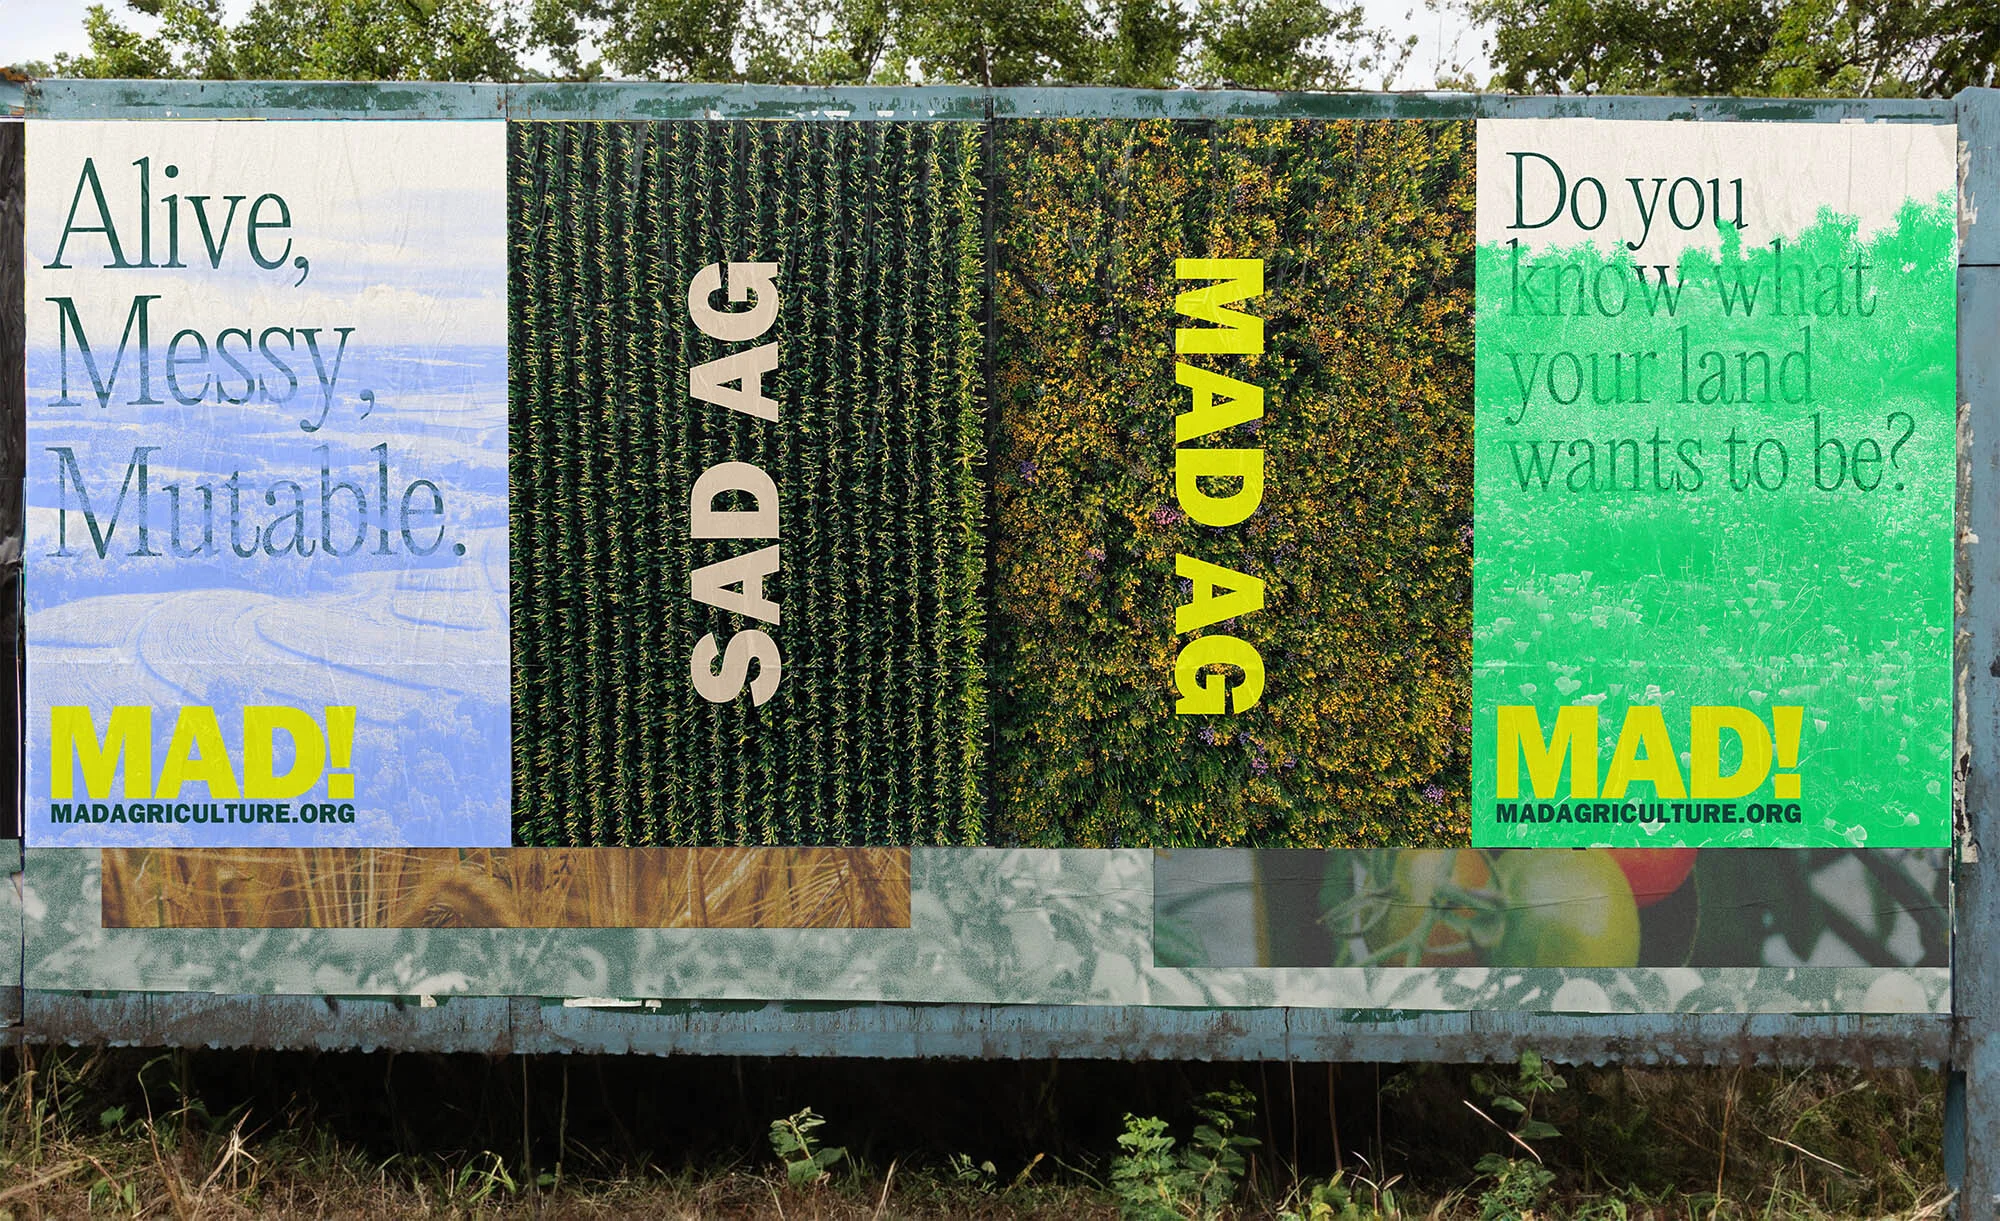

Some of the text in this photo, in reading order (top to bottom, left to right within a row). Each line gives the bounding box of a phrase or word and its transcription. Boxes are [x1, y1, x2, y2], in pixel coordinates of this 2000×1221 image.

[43, 156, 310, 288] Alive,
[1505, 151, 1749, 251] Do you
[1505, 238, 1877, 318] know what
[45, 295, 375, 432] Messy,
[1504, 325, 1814, 426] your land
[45, 443, 467, 559] Mutable.
[688, 261, 782, 707] SAD AG
[1174, 258, 1265, 715] MAD AG
[1508, 411, 1915, 493] wants to be?
[50, 705, 357, 799] MAD!
[1496, 705, 1804, 799] MAD!
[50, 803, 356, 824] MADAGRICULTURE.ORG
[1496, 803, 1802, 824] MADAGRICULTURE.ORG
